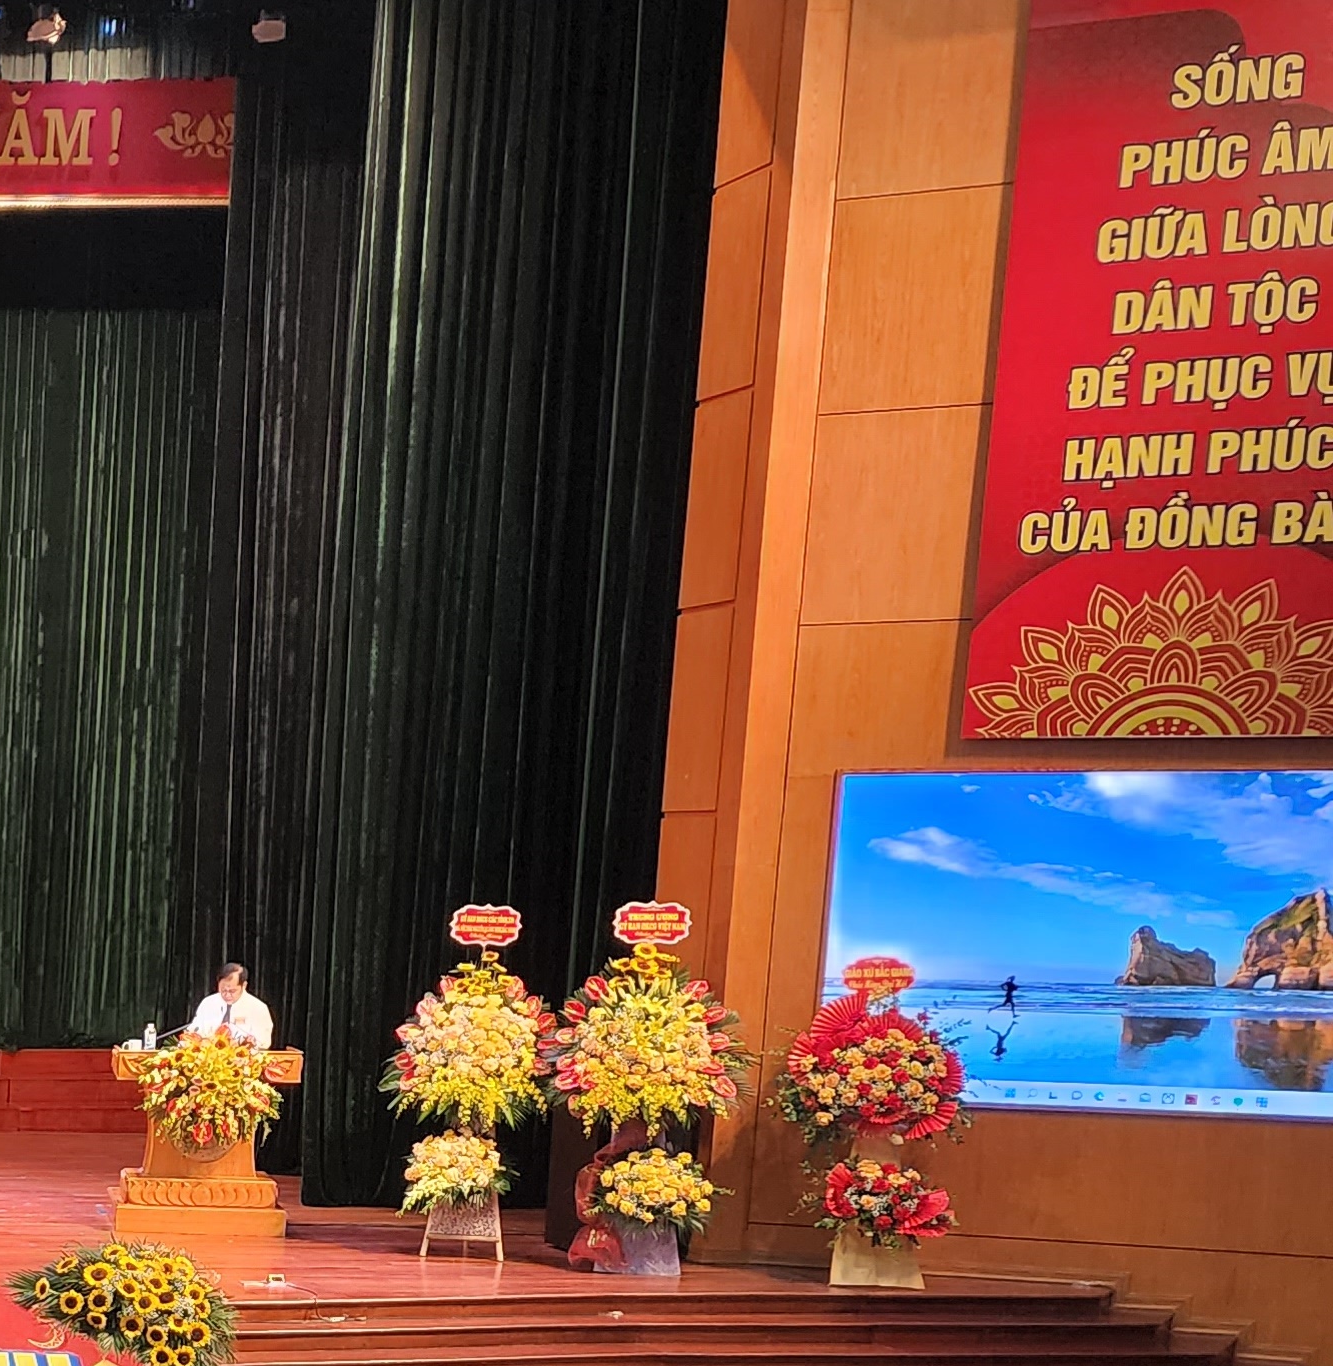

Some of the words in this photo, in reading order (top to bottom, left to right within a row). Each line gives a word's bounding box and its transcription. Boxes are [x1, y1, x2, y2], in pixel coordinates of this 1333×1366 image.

[1171, 46, 1304, 109] SỐNG
[1119, 128, 1247, 189] PHÚC
[1096, 206, 1208, 264] GIỮA
[1112, 279, 1210, 335] DÂN
[1228, 271, 1318, 335] TỘC
[1068, 347, 1135, 410] ĐỂ
[1142, 354, 1271, 411] PHỤC
[1063, 435, 1193, 489] HẠNH
[1206, 418, 1333, 475] PHÚC
[1019, 497, 1111, 555] CỦA
[1125, 491, 1257, 551] ĐỒNG
